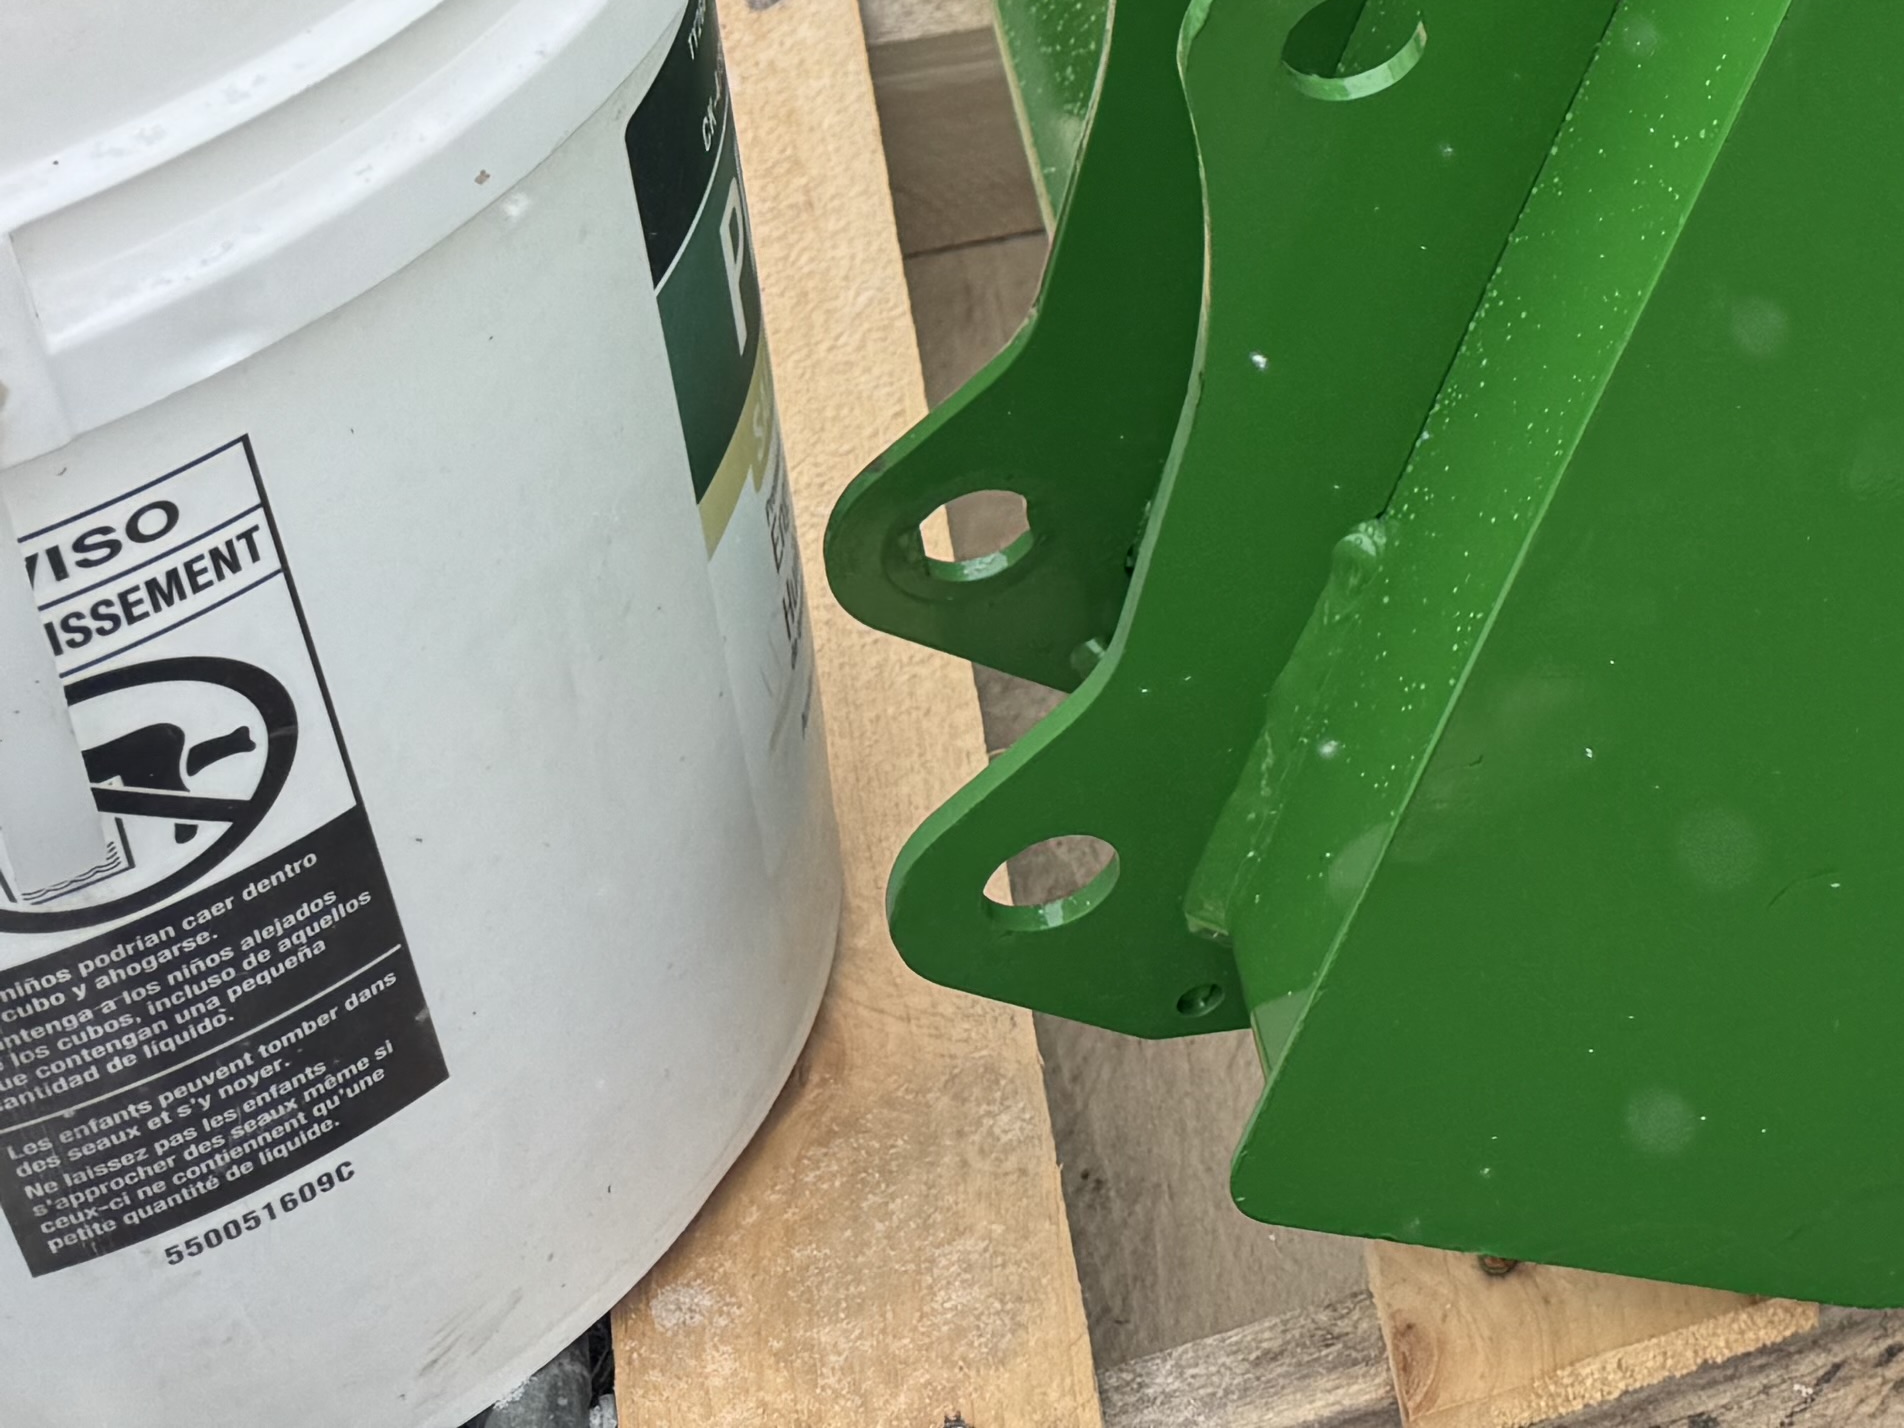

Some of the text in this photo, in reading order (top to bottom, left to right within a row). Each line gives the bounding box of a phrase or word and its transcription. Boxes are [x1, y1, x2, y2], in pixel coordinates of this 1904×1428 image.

[43, 523, 261, 657] ISSEMENT
[0, 968, 72, 1003] niños
[182, 896, 234, 931] caer
[242, 852, 317, 901] dentro
[1, 929, 218, 1022] cubo y ahogarse.
[10, 890, 371, 1067] los cubos, incluso de aquellos
[101, 998, 117, 1015] a
[122, 980, 161, 1005] los
[167, 945, 234, 986] niños
[240, 890, 337, 952] alejados
[7, 972, 397, 1161] Les enfants peuvent tomber dans
[35, 1017, 168, 1079] contengan
[174, 995, 221, 1025] una
[226, 939, 326, 1003] pequeña
[0, 1065, 100, 1112] antidad
[106, 1052, 137, 1074] de
[16, 1058, 291, 1178] des seaux et s'y noyer.
[24, 1060, 326, 1200] Ne laissez pas les enfants
[33, 1039, 394, 1217] s'approcher des seaux même si
[40, 1067, 385, 1234] ceux-ci ne contiennent qu'une
[47, 1118, 340, 1254] petite quantité de liquide.
[164, 1160, 355, 1266] 550051609C
